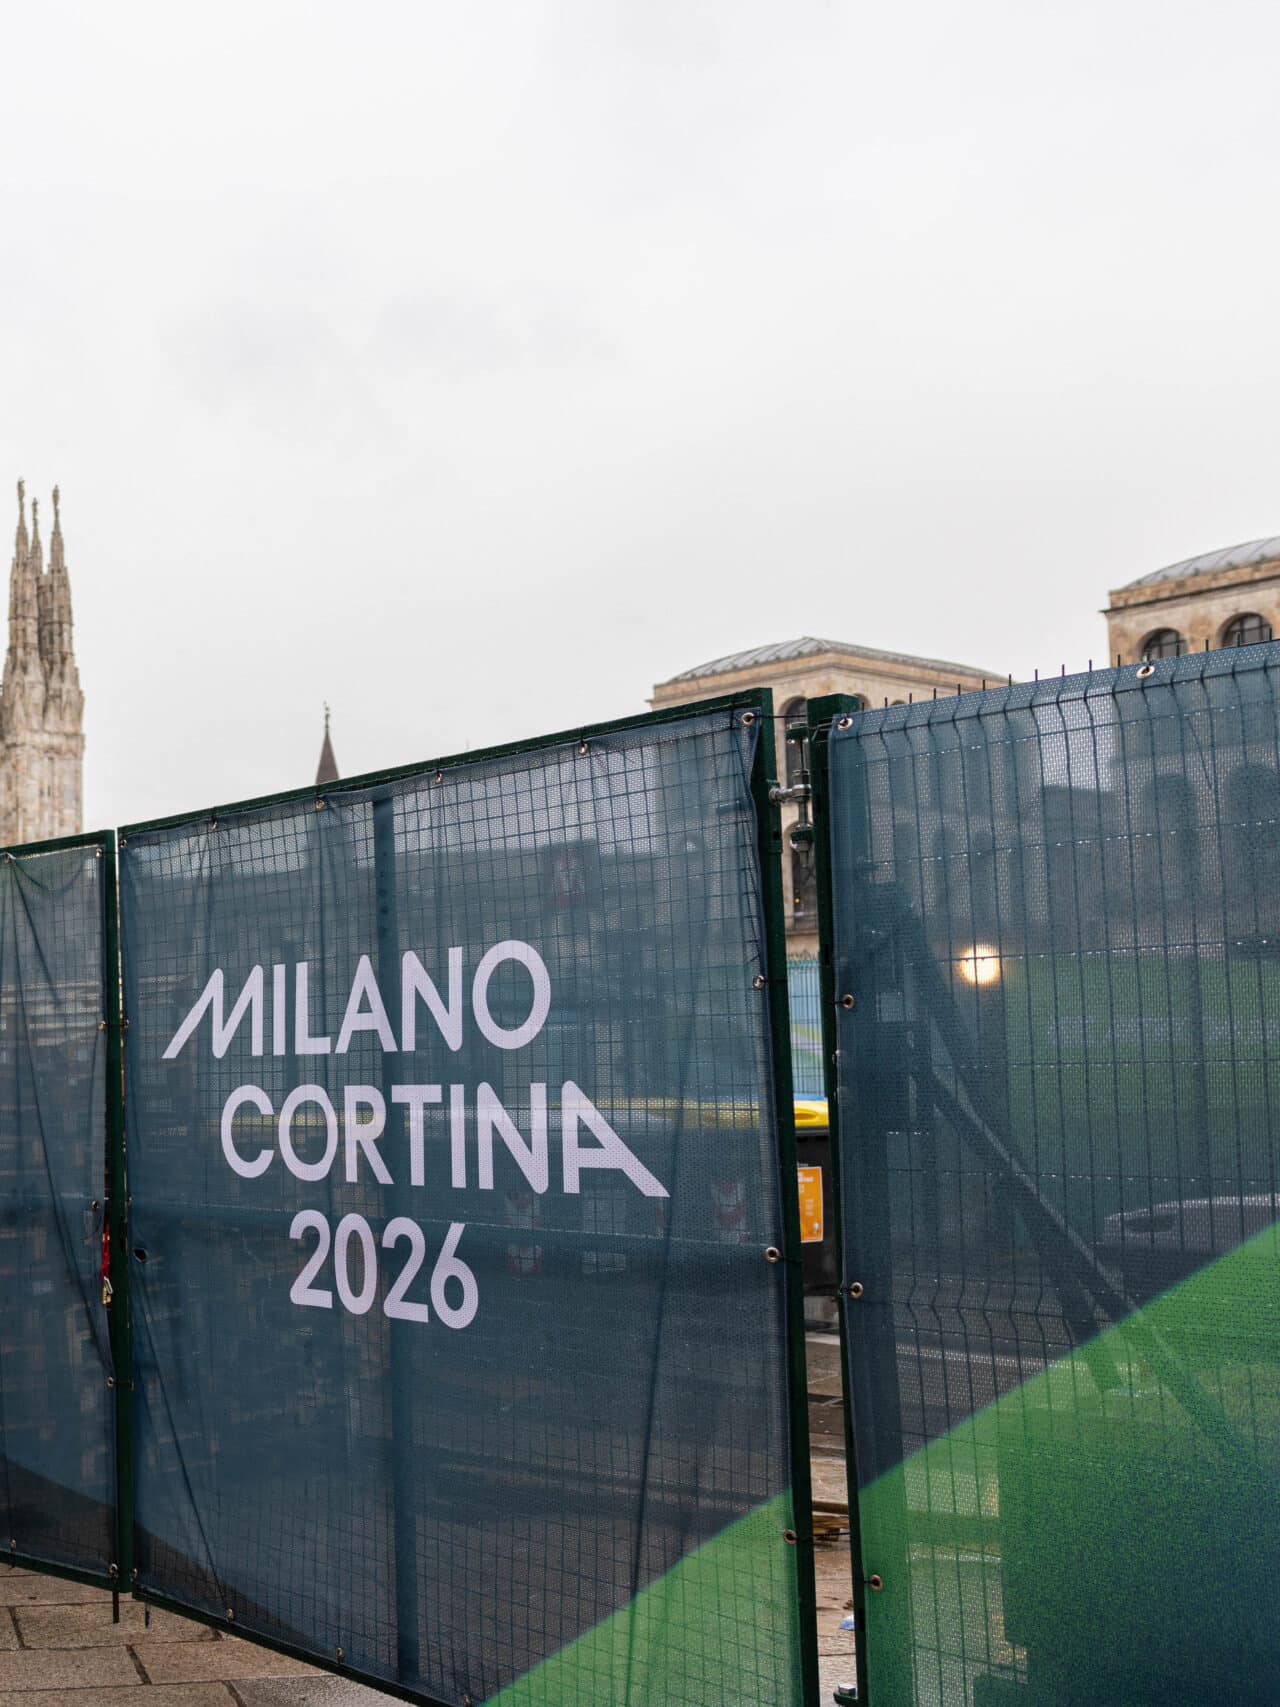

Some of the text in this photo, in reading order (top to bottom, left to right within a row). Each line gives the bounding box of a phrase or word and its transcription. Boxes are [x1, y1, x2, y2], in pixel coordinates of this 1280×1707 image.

[162, 940, 551, 1059] MILANO
[221, 1081, 670, 1198] CORTINA
[289, 1210, 478, 1329] 2026
